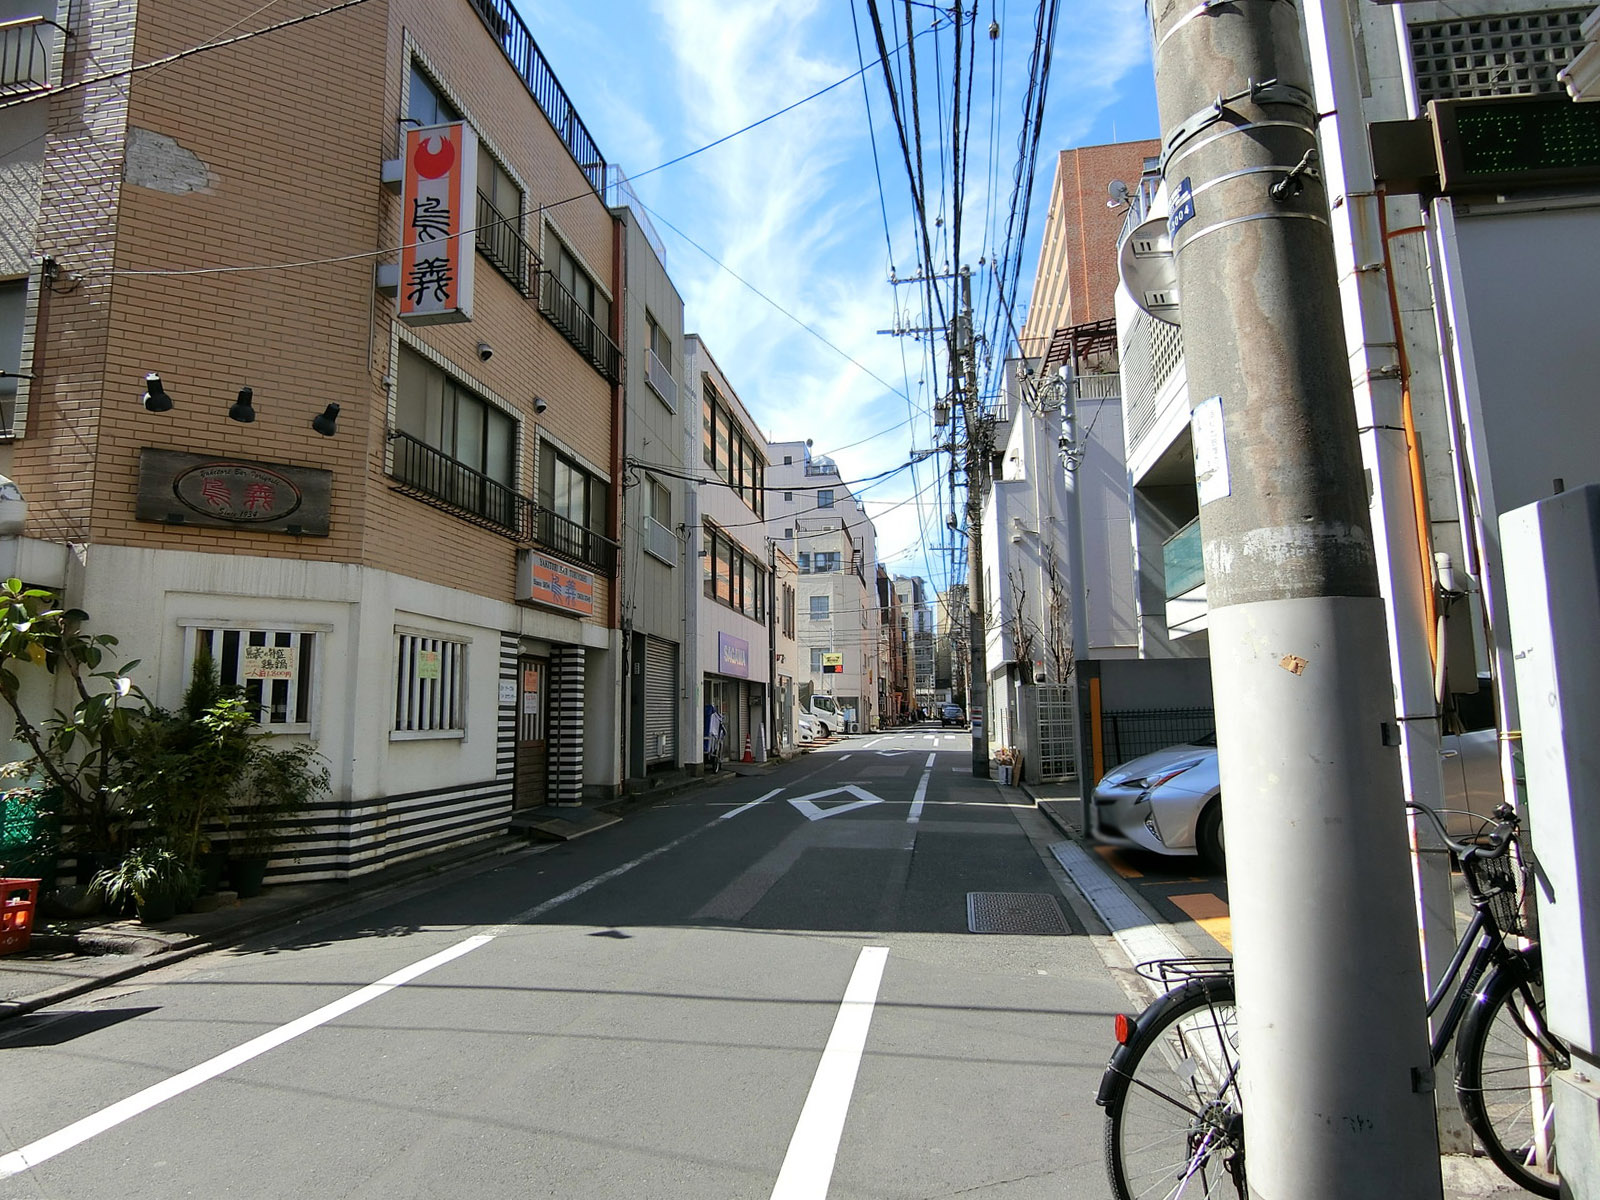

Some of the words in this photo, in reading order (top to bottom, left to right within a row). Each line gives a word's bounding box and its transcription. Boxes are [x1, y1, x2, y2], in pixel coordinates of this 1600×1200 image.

[407, 197, 453, 306] 鳥義
[202, 477, 276, 512] 鳥義
[551, 573, 577, 606] 鳥義
